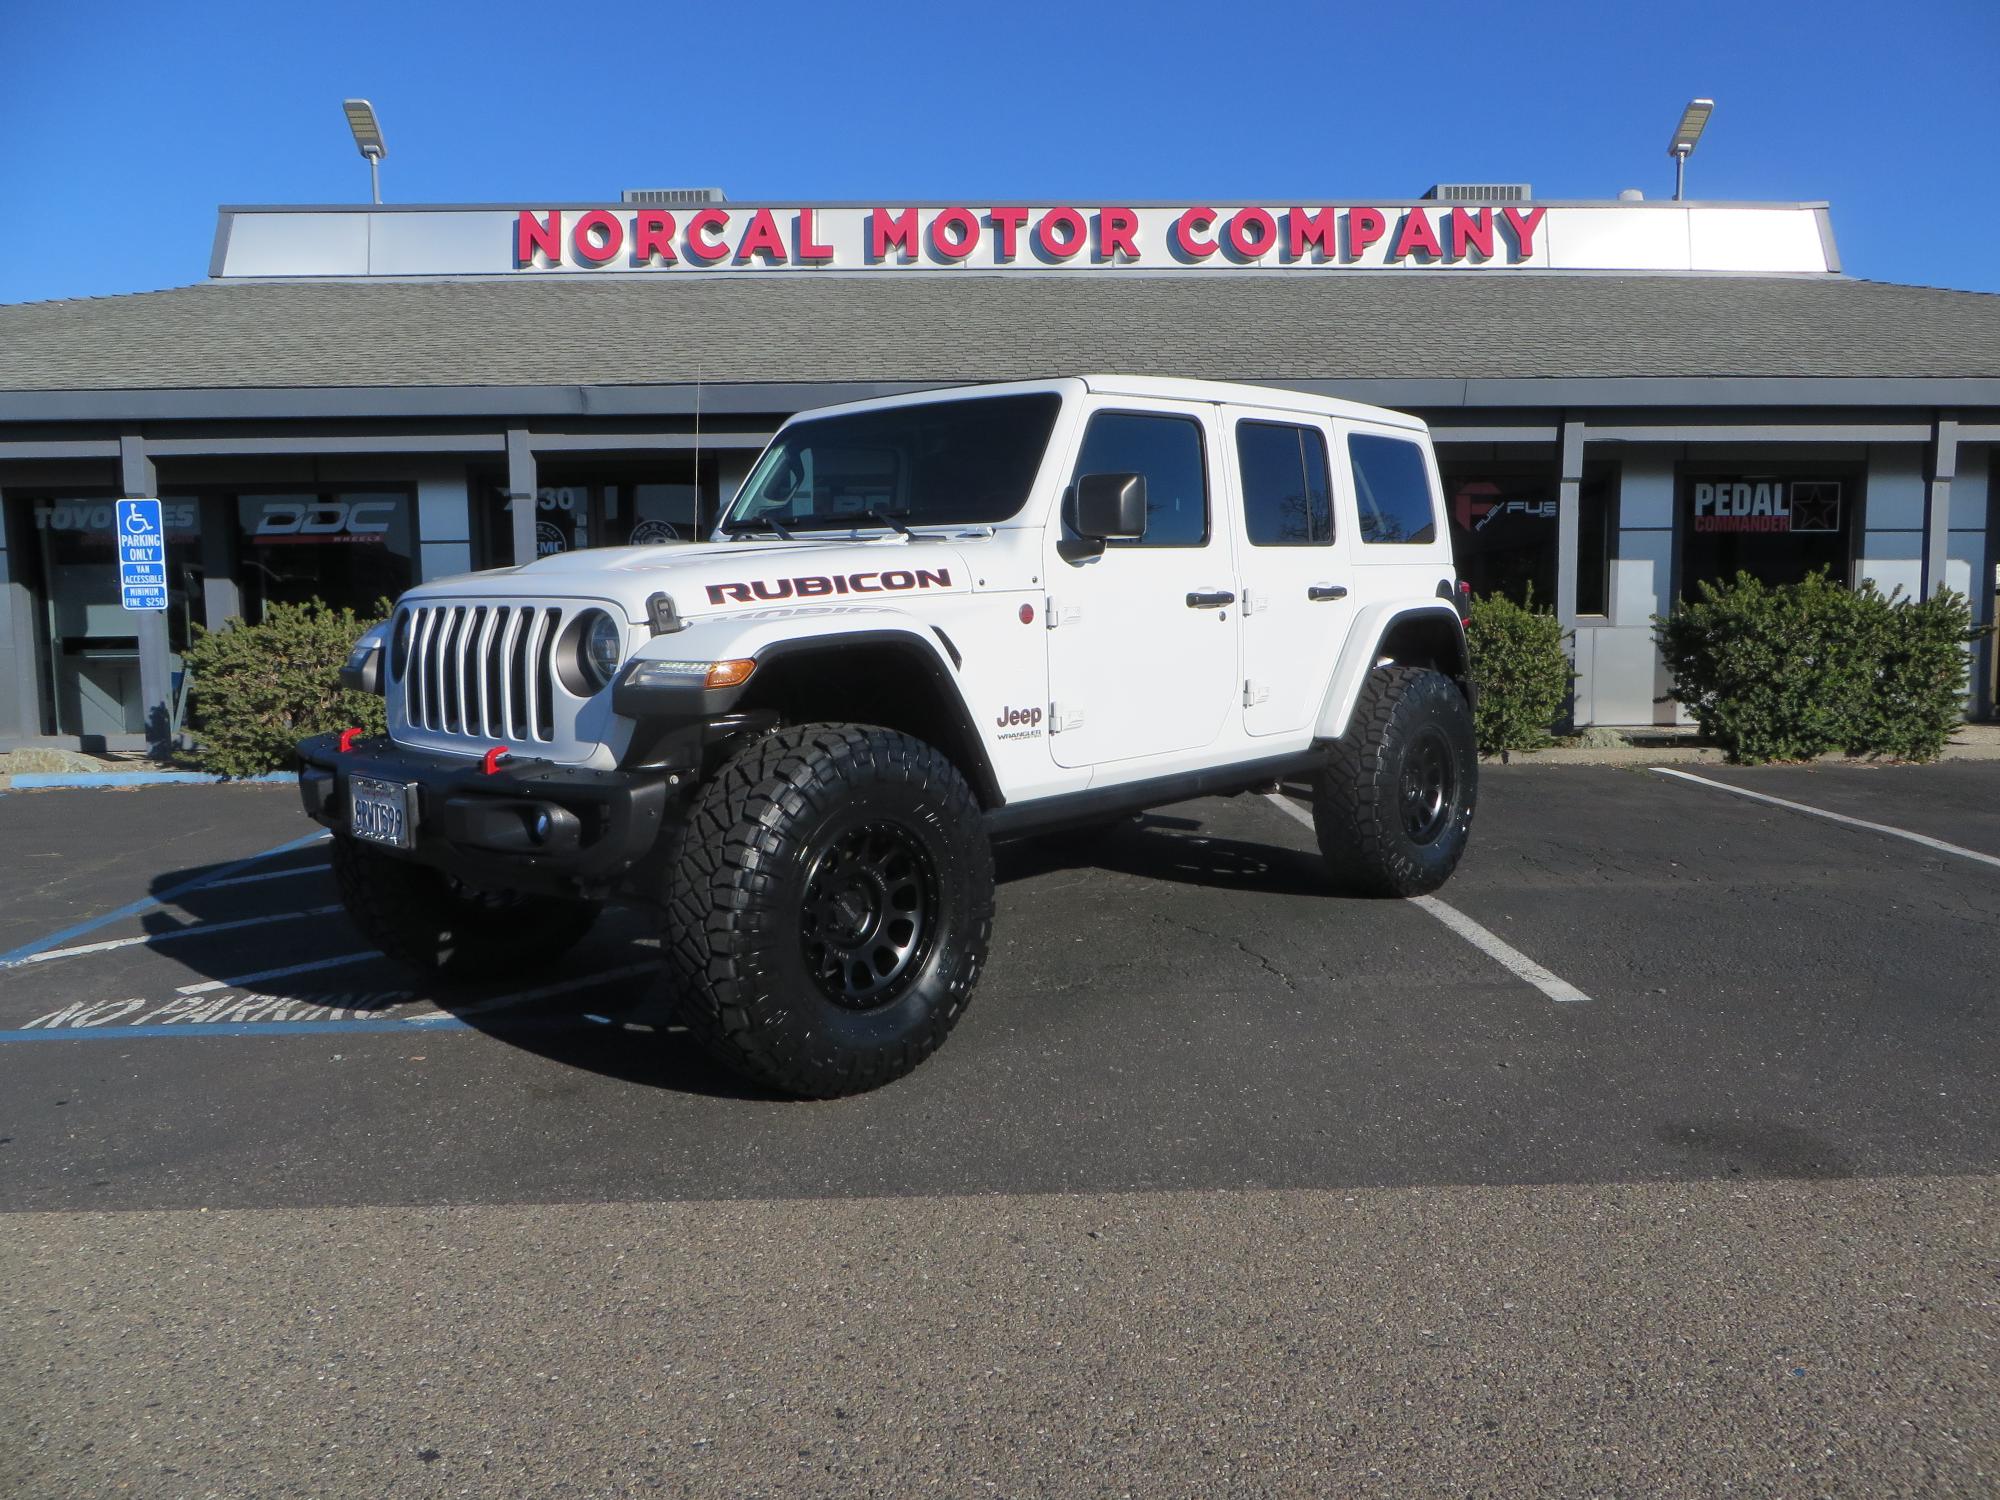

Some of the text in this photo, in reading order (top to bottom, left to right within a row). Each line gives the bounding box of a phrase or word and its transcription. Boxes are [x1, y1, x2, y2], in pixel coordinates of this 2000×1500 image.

[518, 207, 1547, 261] NORCAL MOTOR COMPANY
[1694, 483, 1790, 516] PEDAL
[33, 505, 112, 529] TOYO
[256, 502, 397, 534] DDC
[1695, 516, 1790, 532] COMMANDER
[121, 534, 161, 547] PARKING
[129, 548, 154, 561] ONLY
[135, 565, 151, 573] VAN
[124, 574, 163, 584] ACCESSIBLE
[705, 568, 953, 605] RUBICON
[129, 587, 160, 596] MINIMUM
[125, 597, 165, 606] FINE $250
[997, 706, 1042, 727] Jeep
[19, 992, 413, 1030] NO PARKING
